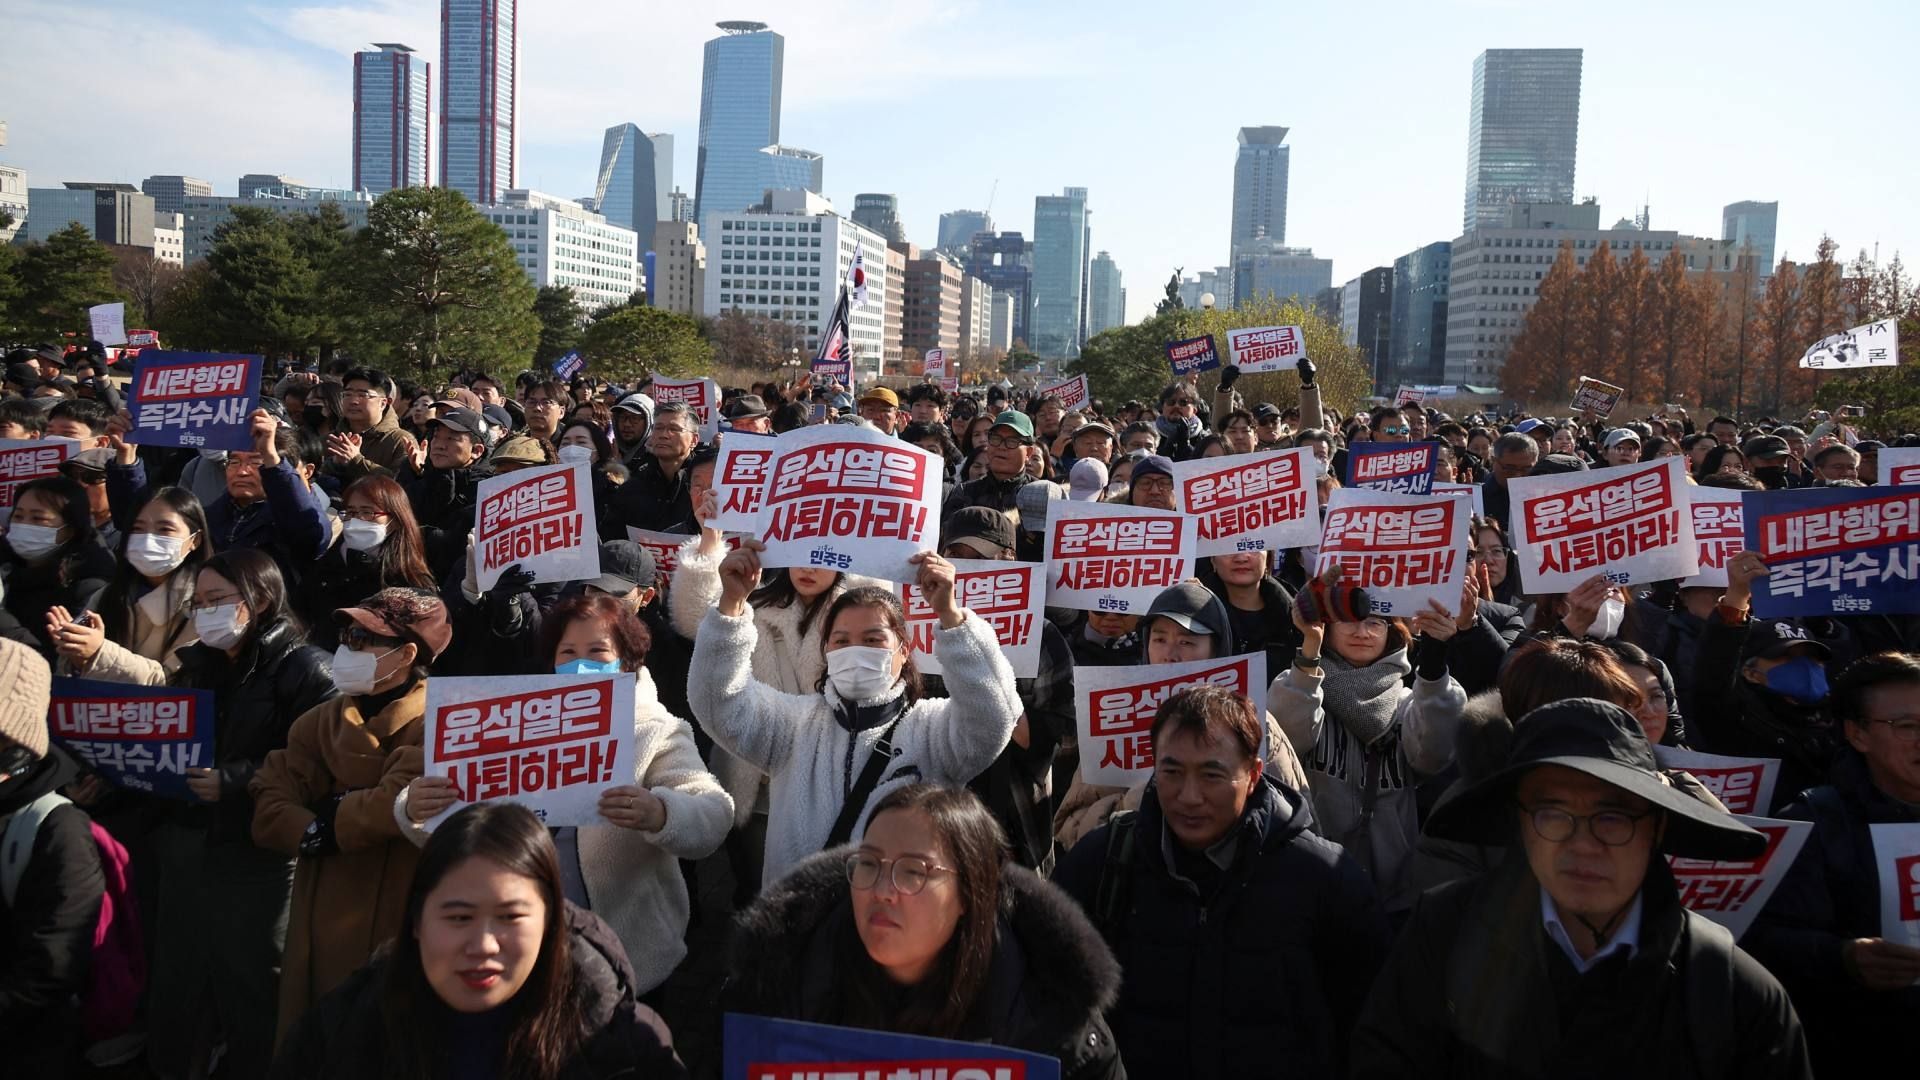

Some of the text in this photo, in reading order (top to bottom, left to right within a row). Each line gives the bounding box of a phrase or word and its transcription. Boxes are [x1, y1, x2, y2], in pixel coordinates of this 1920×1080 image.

[97, 196, 115, 206] BnB
[1237, 329, 1291, 347] 윤석열은
[1239, 341, 1298, 364] 사퇴하라!
[142, 363, 245, 397] 내란행위
[138, 397, 249, 431] 즉각수사!
[776, 448, 917, 497] 윤석열은
[1357, 449, 1428, 478] 내란행위
[1190, 459, 1294, 510] 윤석열은
[483, 475, 568, 535] 윤석열은
[762, 497, 928, 543] 사퇴하라!
[1197, 490, 1307, 541] 사퇴하라!
[1533, 472, 1664, 537] 윤석열은
[484, 513, 583, 575] 사퇴하라!
[1060, 520, 1174, 554] 윤석열은
[1324, 507, 1445, 547] 윤석열은
[1538, 510, 1679, 576] 사퇴하라!
[1767, 497, 1920, 555] 내란행위
[810, 550, 853, 569] 민주당
[1236, 539, 1265, 551] 민주당
[1056, 557, 1184, 591] 사퇴하라!
[1768, 543, 1920, 598] 즉각수사
[1098, 598, 1130, 612] 민주당
[1832, 598, 1873, 612] 민주당
[56, 700, 189, 735] 내란행위
[443, 688, 602, 754] 윤석열은
[447, 739, 619, 803] 사퇴하라!
